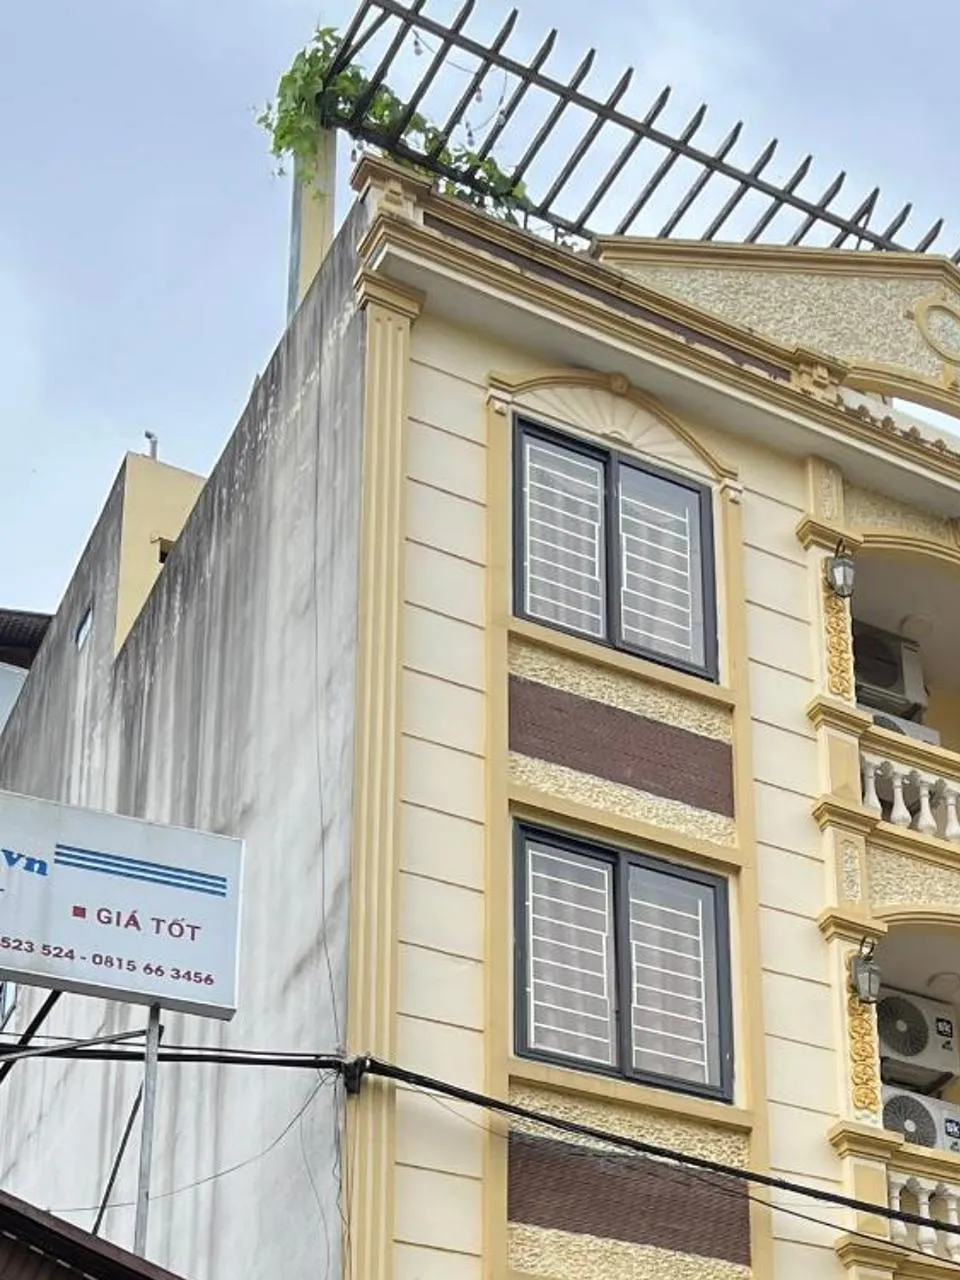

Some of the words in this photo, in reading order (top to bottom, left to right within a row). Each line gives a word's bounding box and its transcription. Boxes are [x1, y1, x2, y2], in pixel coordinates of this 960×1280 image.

[96, 907, 141, 931] GIÁ
[151, 916, 202, 941] TỐT
[0, 936, 34, 953] 523
[41, 944, 75, 961] 524
[92, 953, 137, 972] 0815
[142, 963, 165, 977] 66
[170, 968, 215, 986] 3456
